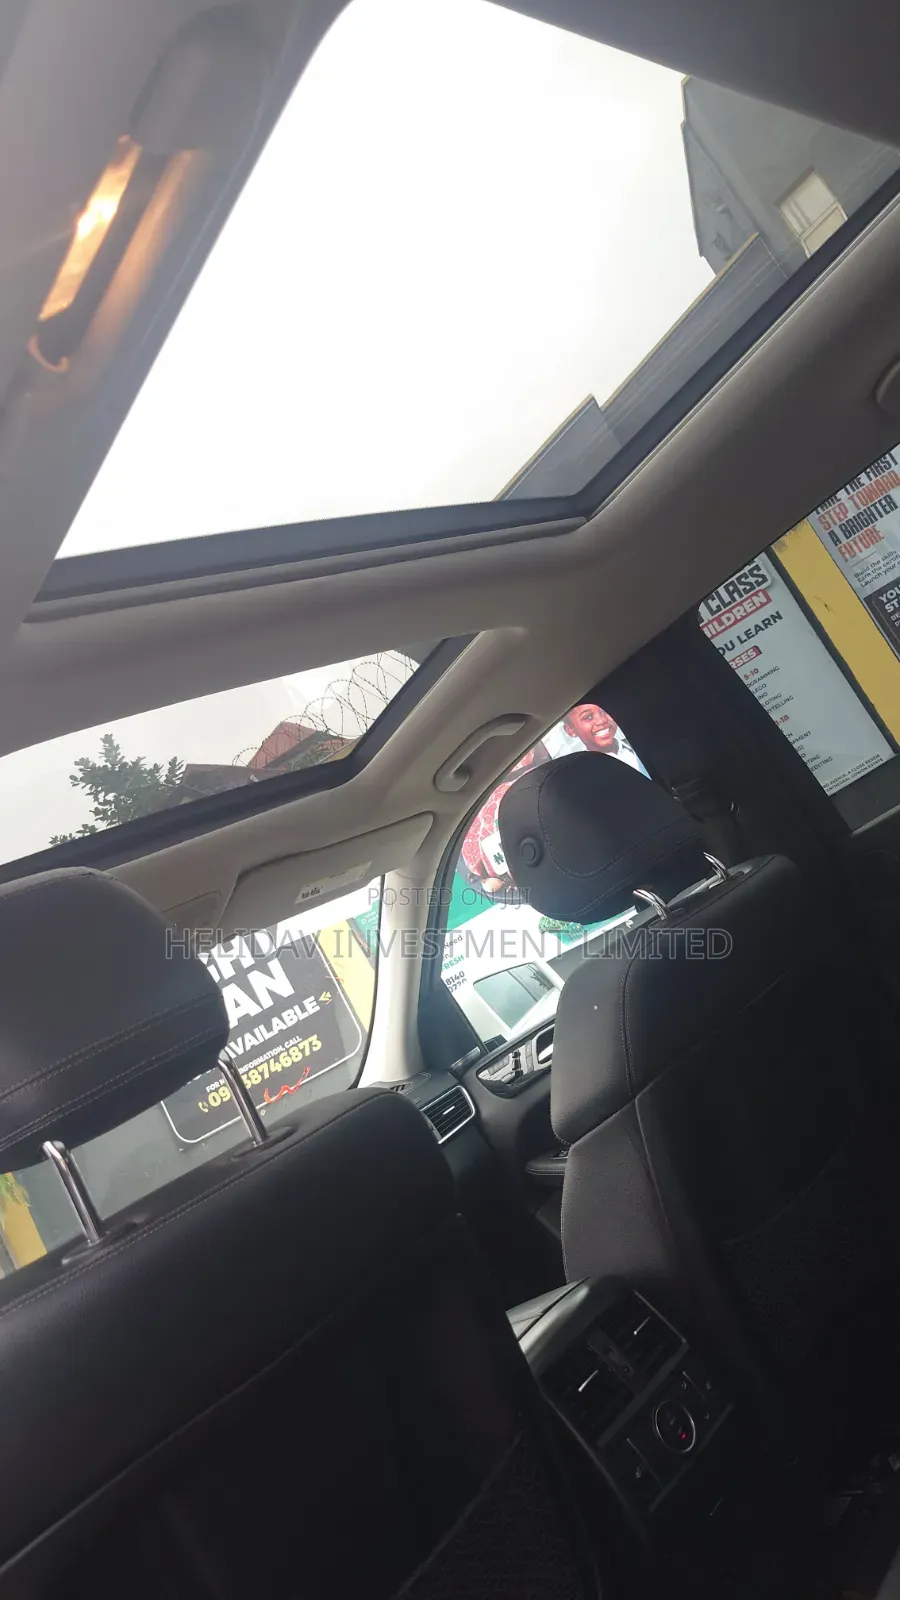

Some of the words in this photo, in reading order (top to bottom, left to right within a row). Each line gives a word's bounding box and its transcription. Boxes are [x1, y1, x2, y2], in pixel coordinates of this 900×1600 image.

[818, 501, 849, 531] STEP
[827, 530, 842, 547] A
[838, 494, 899, 540] BRIGHTER
[837, 524, 885, 563] FUTURE
[702, 564, 769, 616] CLASS
[860, 572, 883, 588] Launch
[736, 611, 783, 644] LEARN
[743, 668, 759, 680] 5-10
[284, 1035, 302, 1048] CALL
